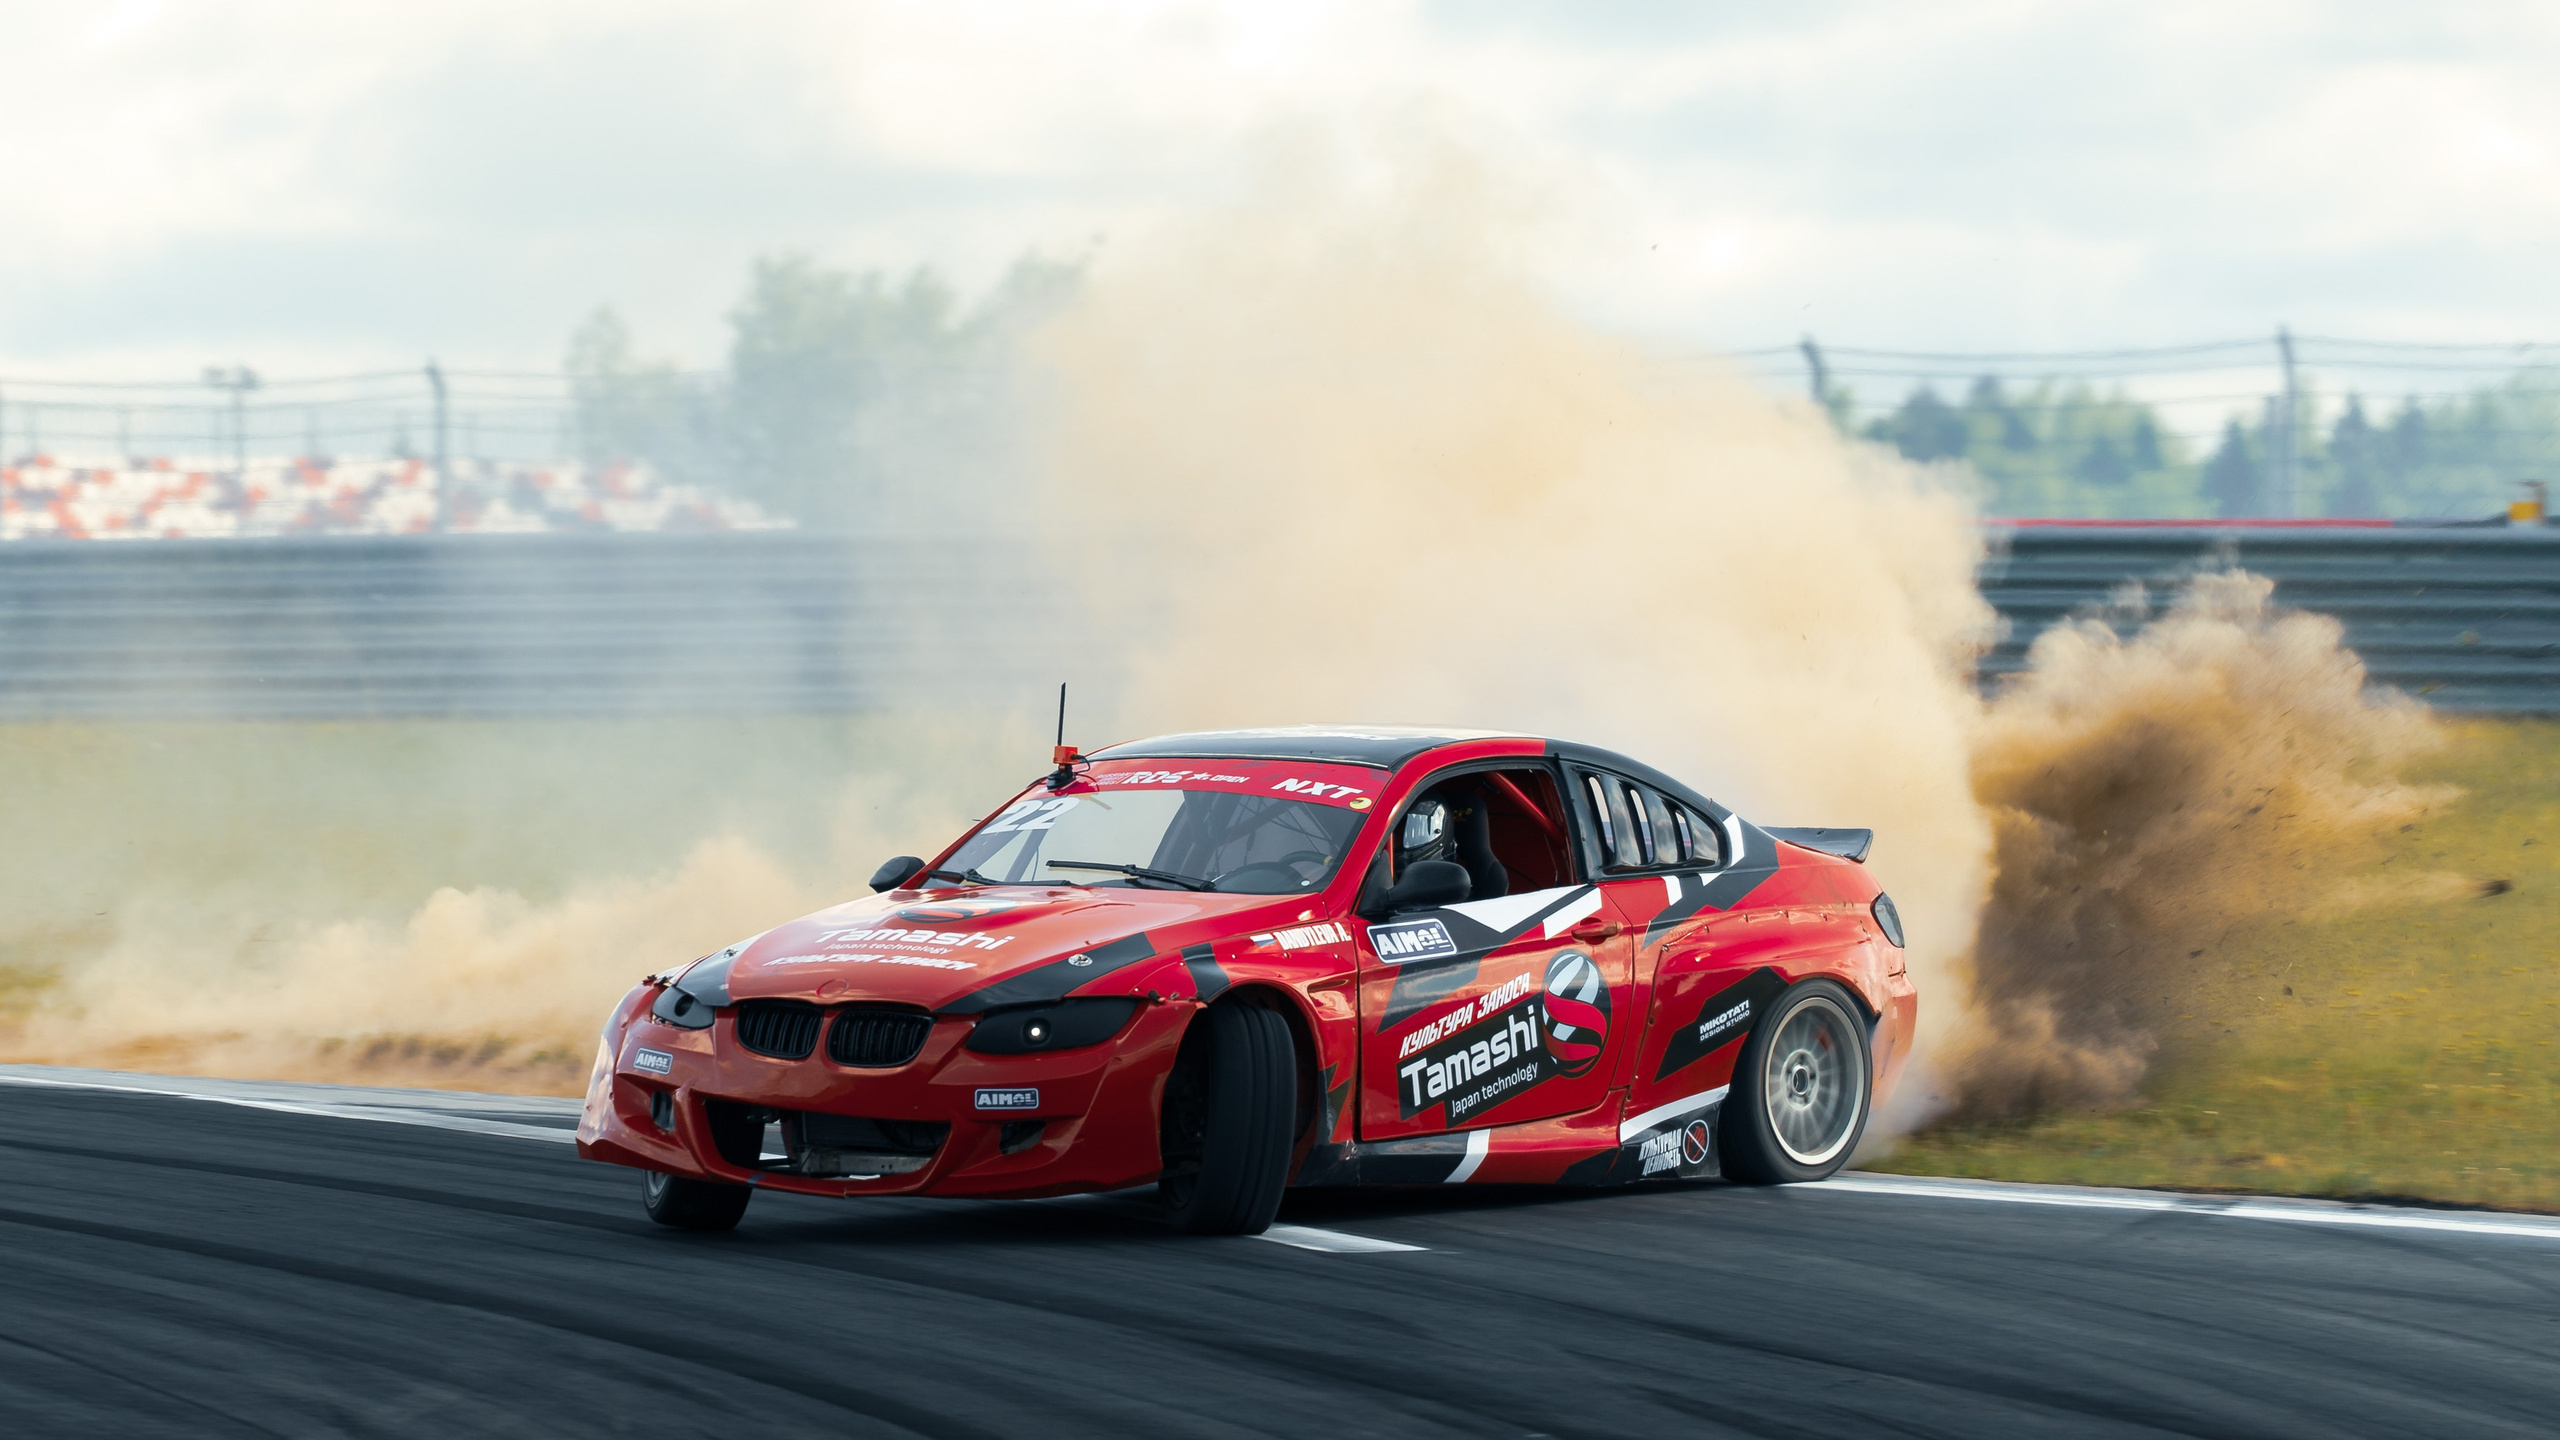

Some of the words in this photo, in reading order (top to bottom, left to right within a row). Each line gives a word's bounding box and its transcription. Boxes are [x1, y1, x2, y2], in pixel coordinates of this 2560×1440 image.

[1121, 770, 1193, 784] RDS
[1210, 774, 1250, 784] OPEN
[1271, 778, 1363, 799] NXT
[980, 797, 1080, 835] 22
[815, 928, 1016, 950] Tamashi
[823, 943, 867, 951] Japan
[869, 943, 954, 955] technology
[1376, 927, 1451, 956] AIMOL
[1399, 1002, 1475, 1059] КУЛЬТУРА
[1477, 972, 1531, 1019] ЗАНОСА
[1699, 1000, 1749, 1034] MIKOTATI
[1700, 1023, 1725, 1041] DESIGN
[1726, 1009, 1750, 1028] STUDIO
[636, 1053, 669, 1068] AIMOL
[1401, 1005, 1538, 1107] Tamashi
[978, 1093, 1036, 1106] AIMOL
[1452, 1091, 1480, 1118] Japan
[1481, 1062, 1539, 1101] technology
